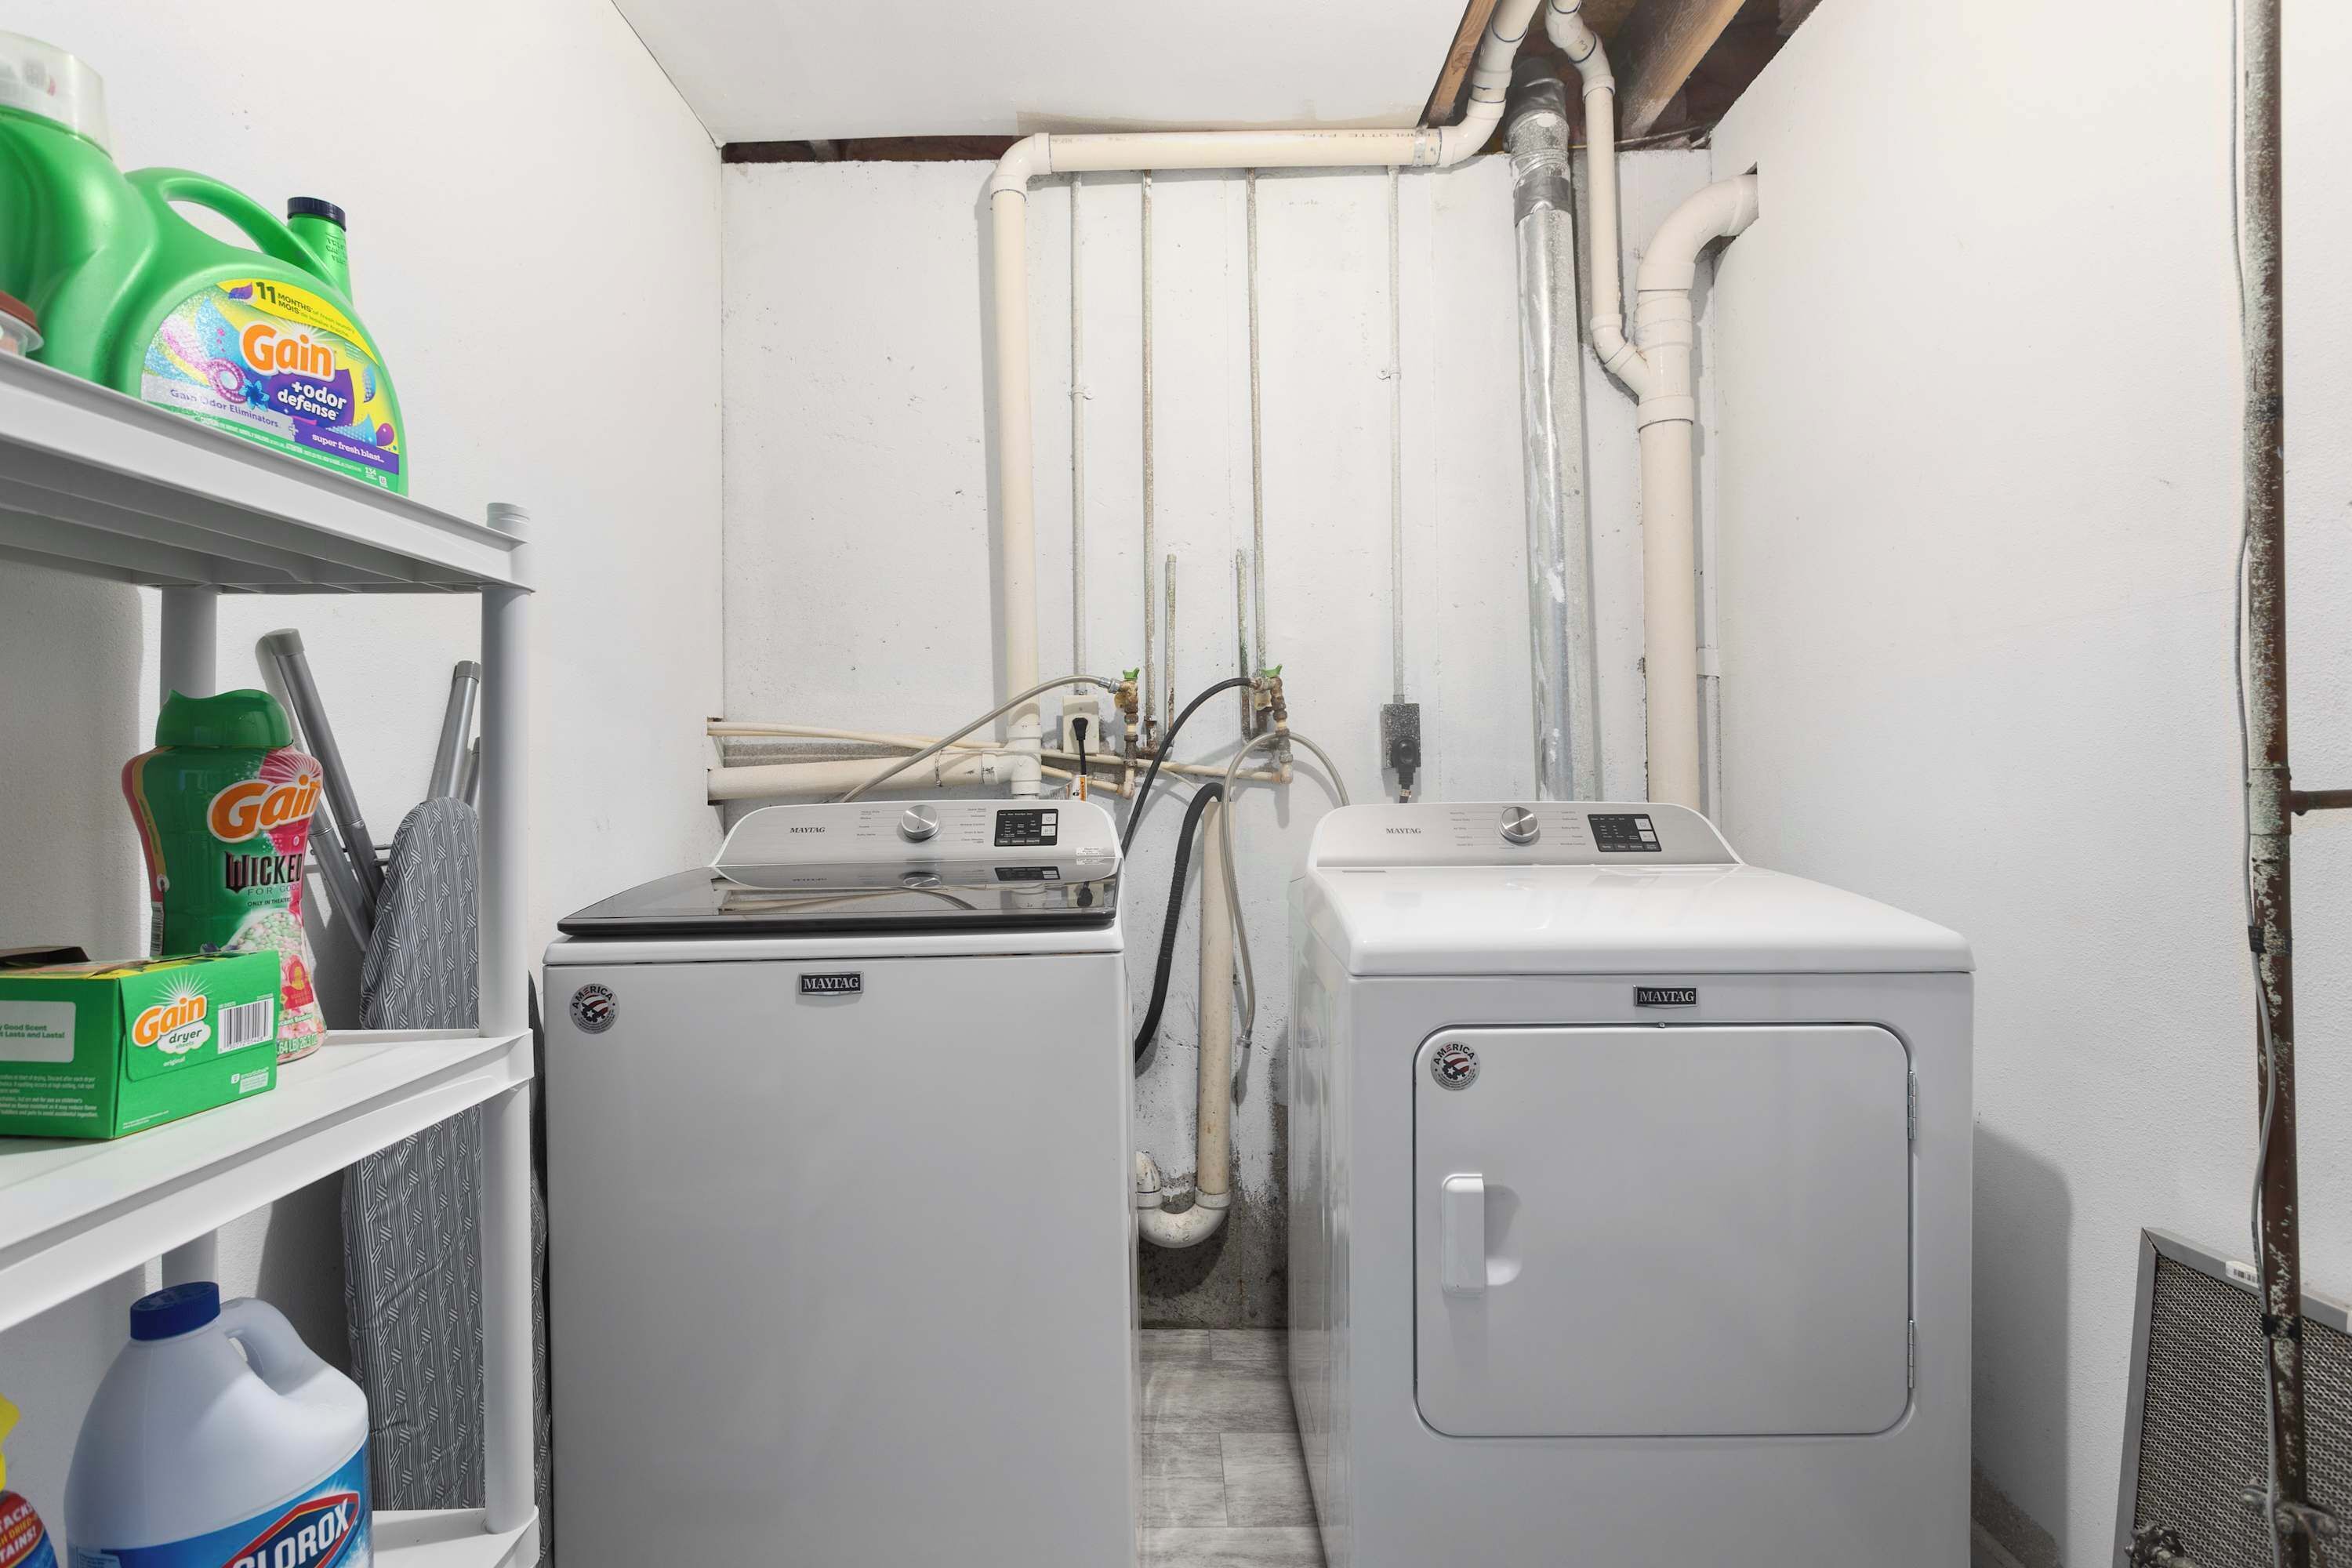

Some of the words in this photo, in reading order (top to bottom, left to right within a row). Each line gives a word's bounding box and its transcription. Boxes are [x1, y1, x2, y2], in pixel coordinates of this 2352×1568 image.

[256, 281, 276, 304] 11
[278, 300, 300, 314] MOIS
[241, 322, 333, 379] Gain
[229, 405, 279, 428] Eliminators
[277, 389, 338, 421] defense
[311, 434, 338, 448] super
[338, 441, 361, 456] fresh
[361, 448, 381, 461] blast
[211, 773, 323, 840] Gain
[224, 851, 303, 894] WICKED
[247, 887, 274, 896] FOR
[803, 977, 859, 989] MAYTAG
[572, 985, 613, 1009] AMERICA
[1639, 990, 1694, 1002] MAYTAG
[134, 996, 205, 1046] Gain
[169, 1028, 203, 1044] dryer
[1433, 1044, 1475, 1065] AMERICA
[0, 1525, 37, 1564] TAINS!
[232, 1497, 350, 1568] OROX
